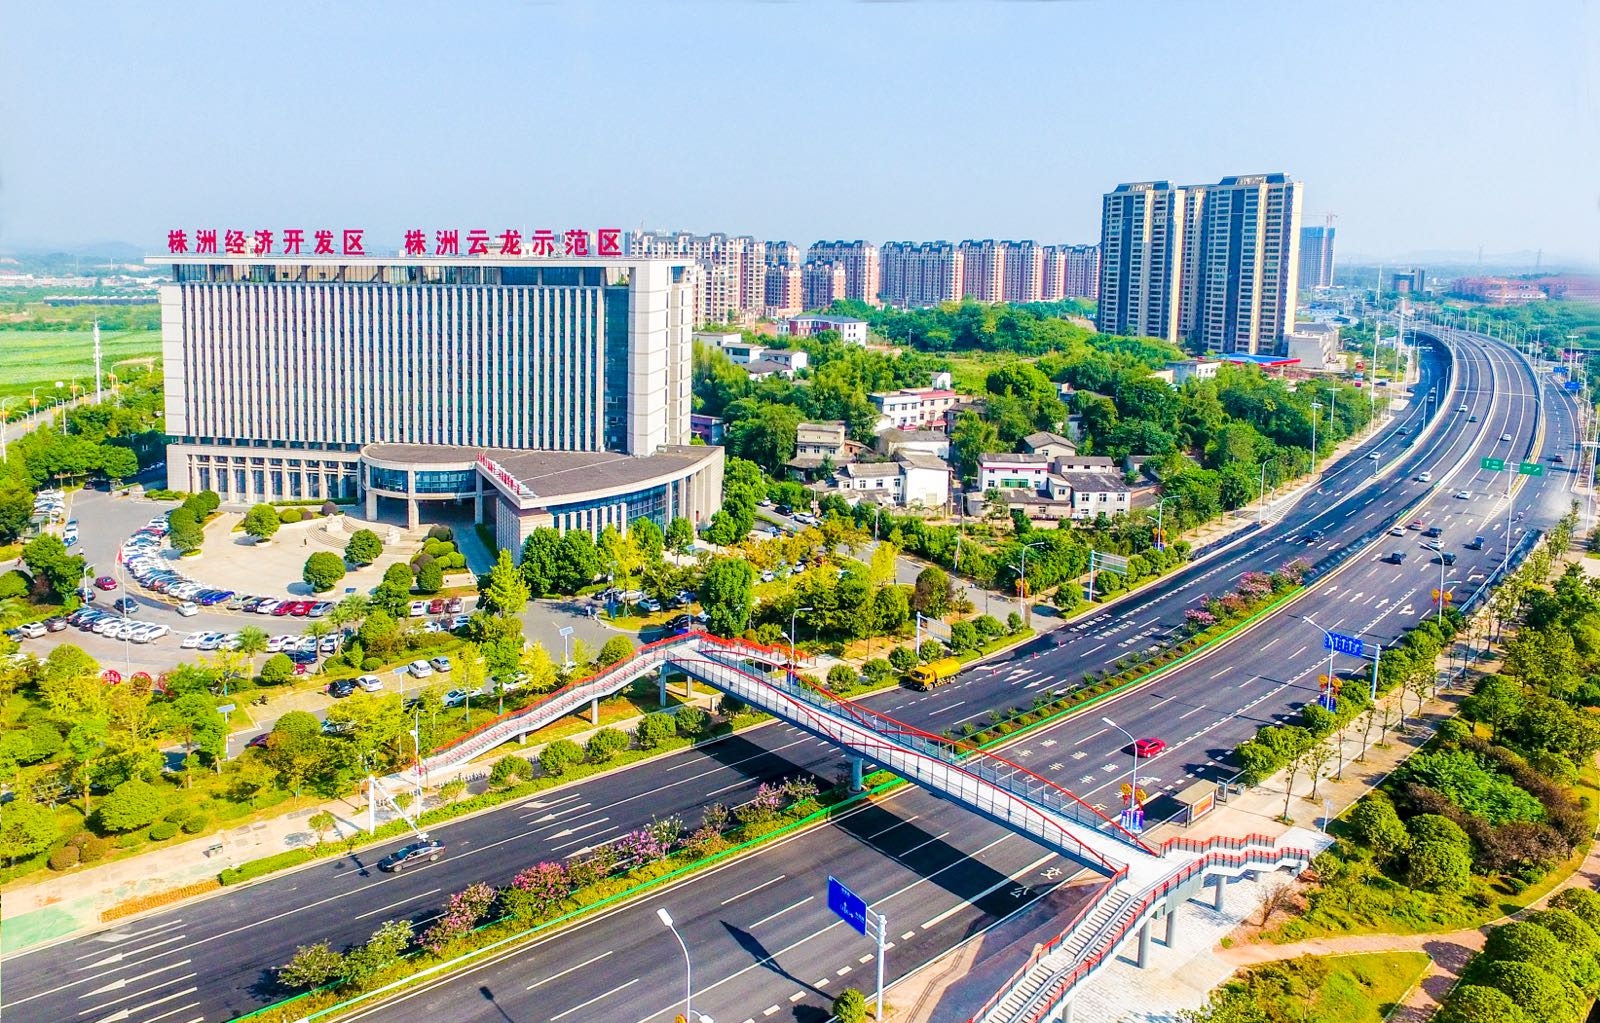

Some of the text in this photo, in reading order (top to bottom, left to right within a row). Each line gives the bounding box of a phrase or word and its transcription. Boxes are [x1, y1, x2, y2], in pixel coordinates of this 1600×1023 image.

[168, 229, 622, 256] 株洲经济开发区 株洲云龙示范区
